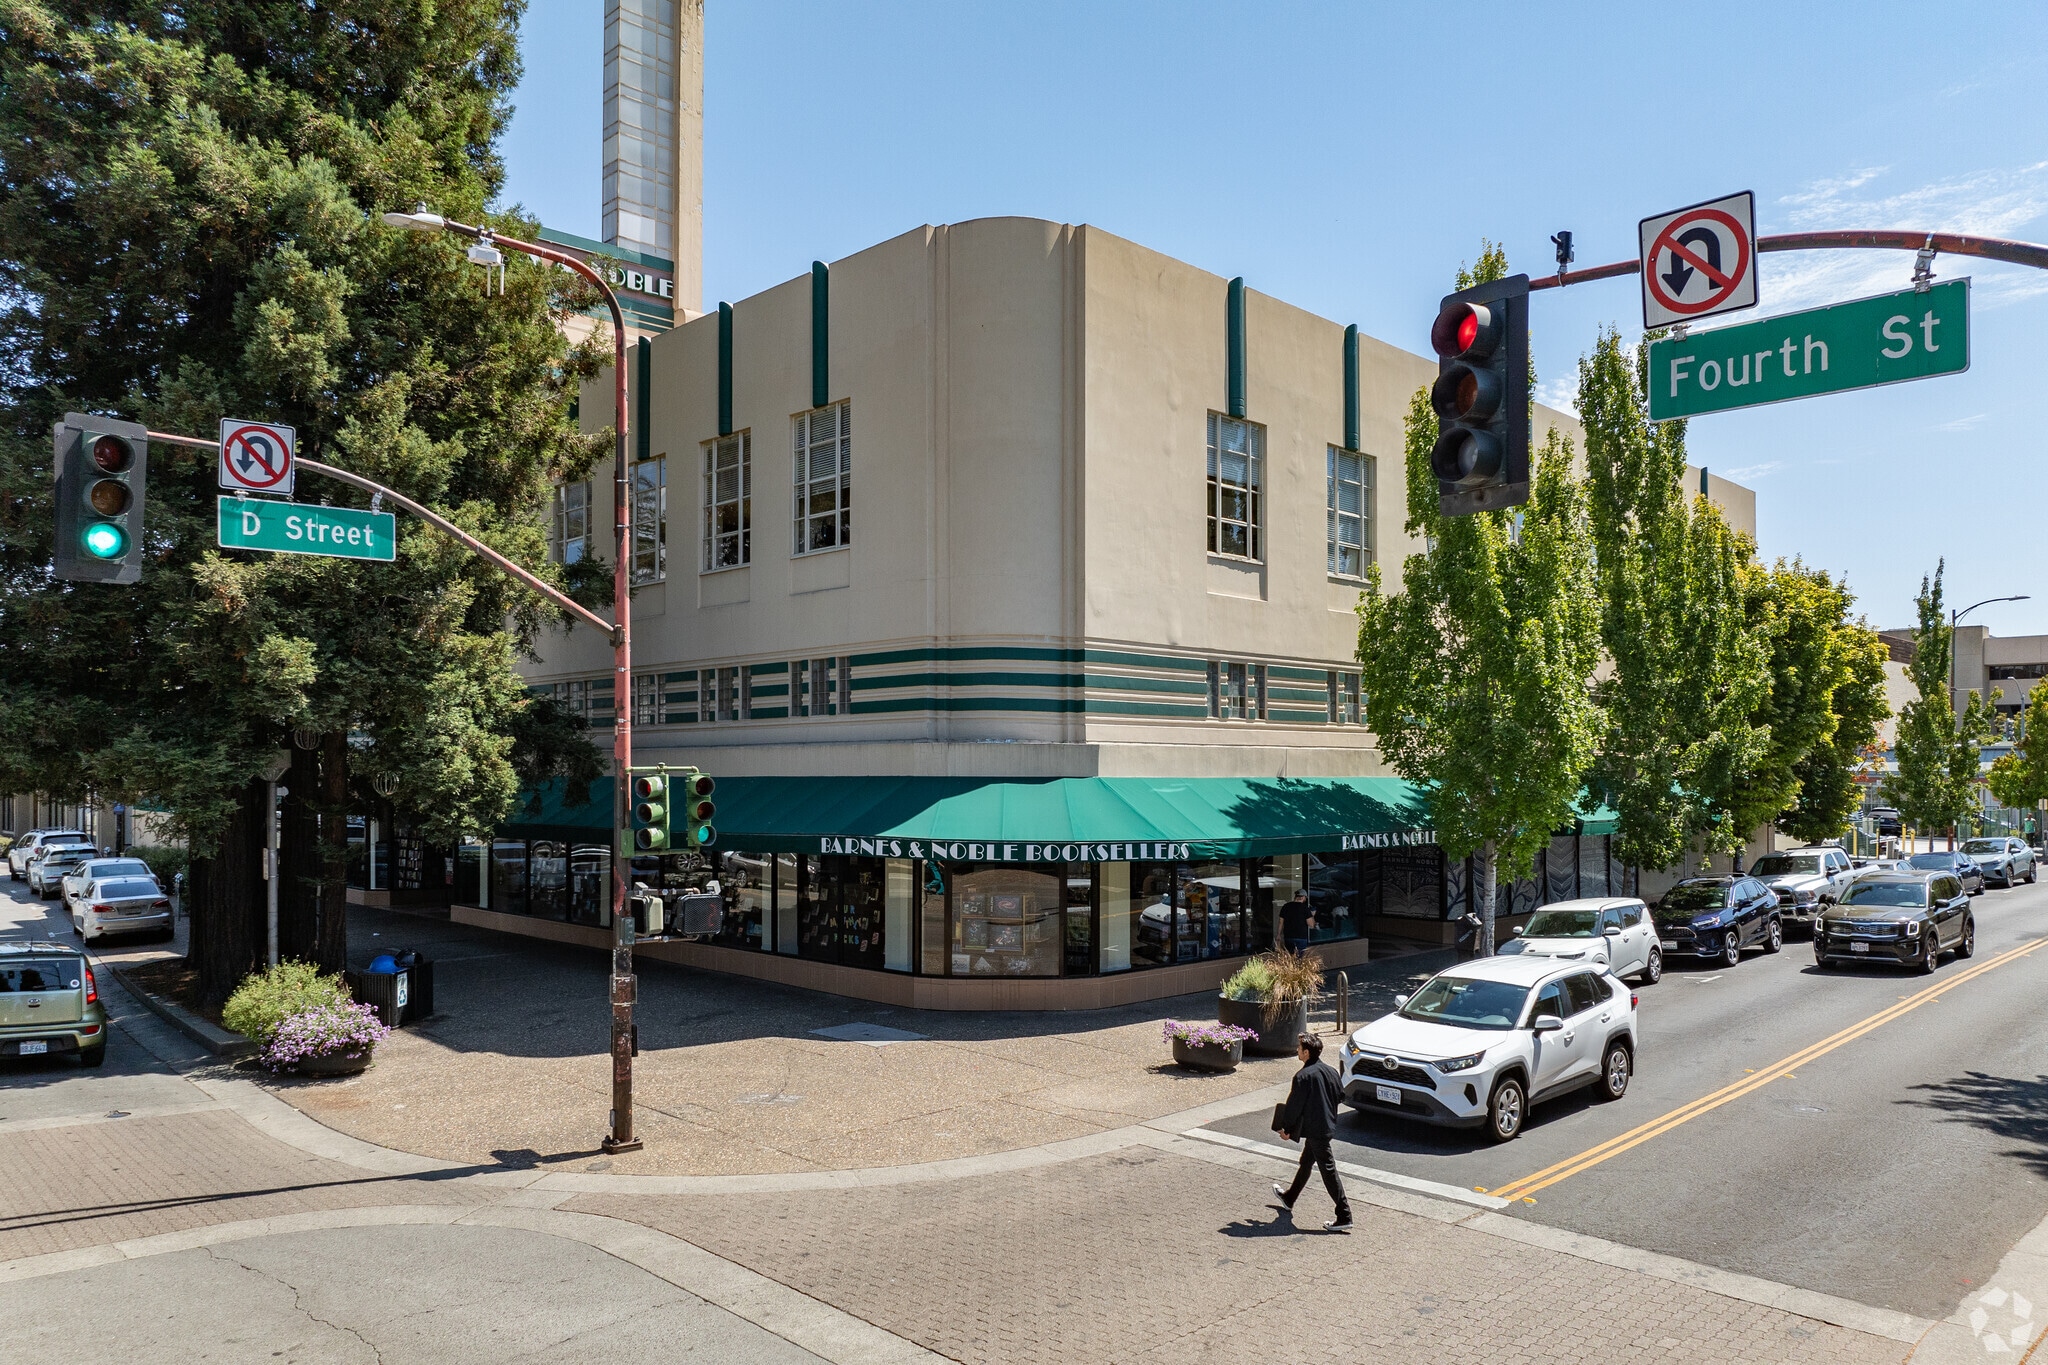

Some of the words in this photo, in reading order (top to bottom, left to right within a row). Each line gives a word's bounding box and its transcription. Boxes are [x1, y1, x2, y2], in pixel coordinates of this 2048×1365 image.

[602, 265, 673, 299] OBLE
[1670, 334, 1828, 397] Fourth
[1881, 310, 1940, 359] St
[242, 511, 261, 536] D
[285, 515, 374, 547] Street
[820, 837, 902, 858] BARNES
[908, 841, 924, 858] &
[931, 842, 1018, 861] NOBLE
[1025, 843, 1190, 862] BOOKSELLERS
[1342, 832, 1389, 850] BARNES
[1392, 832, 1400, 846] &
[1402, 830, 1438, 845] NOBLE
